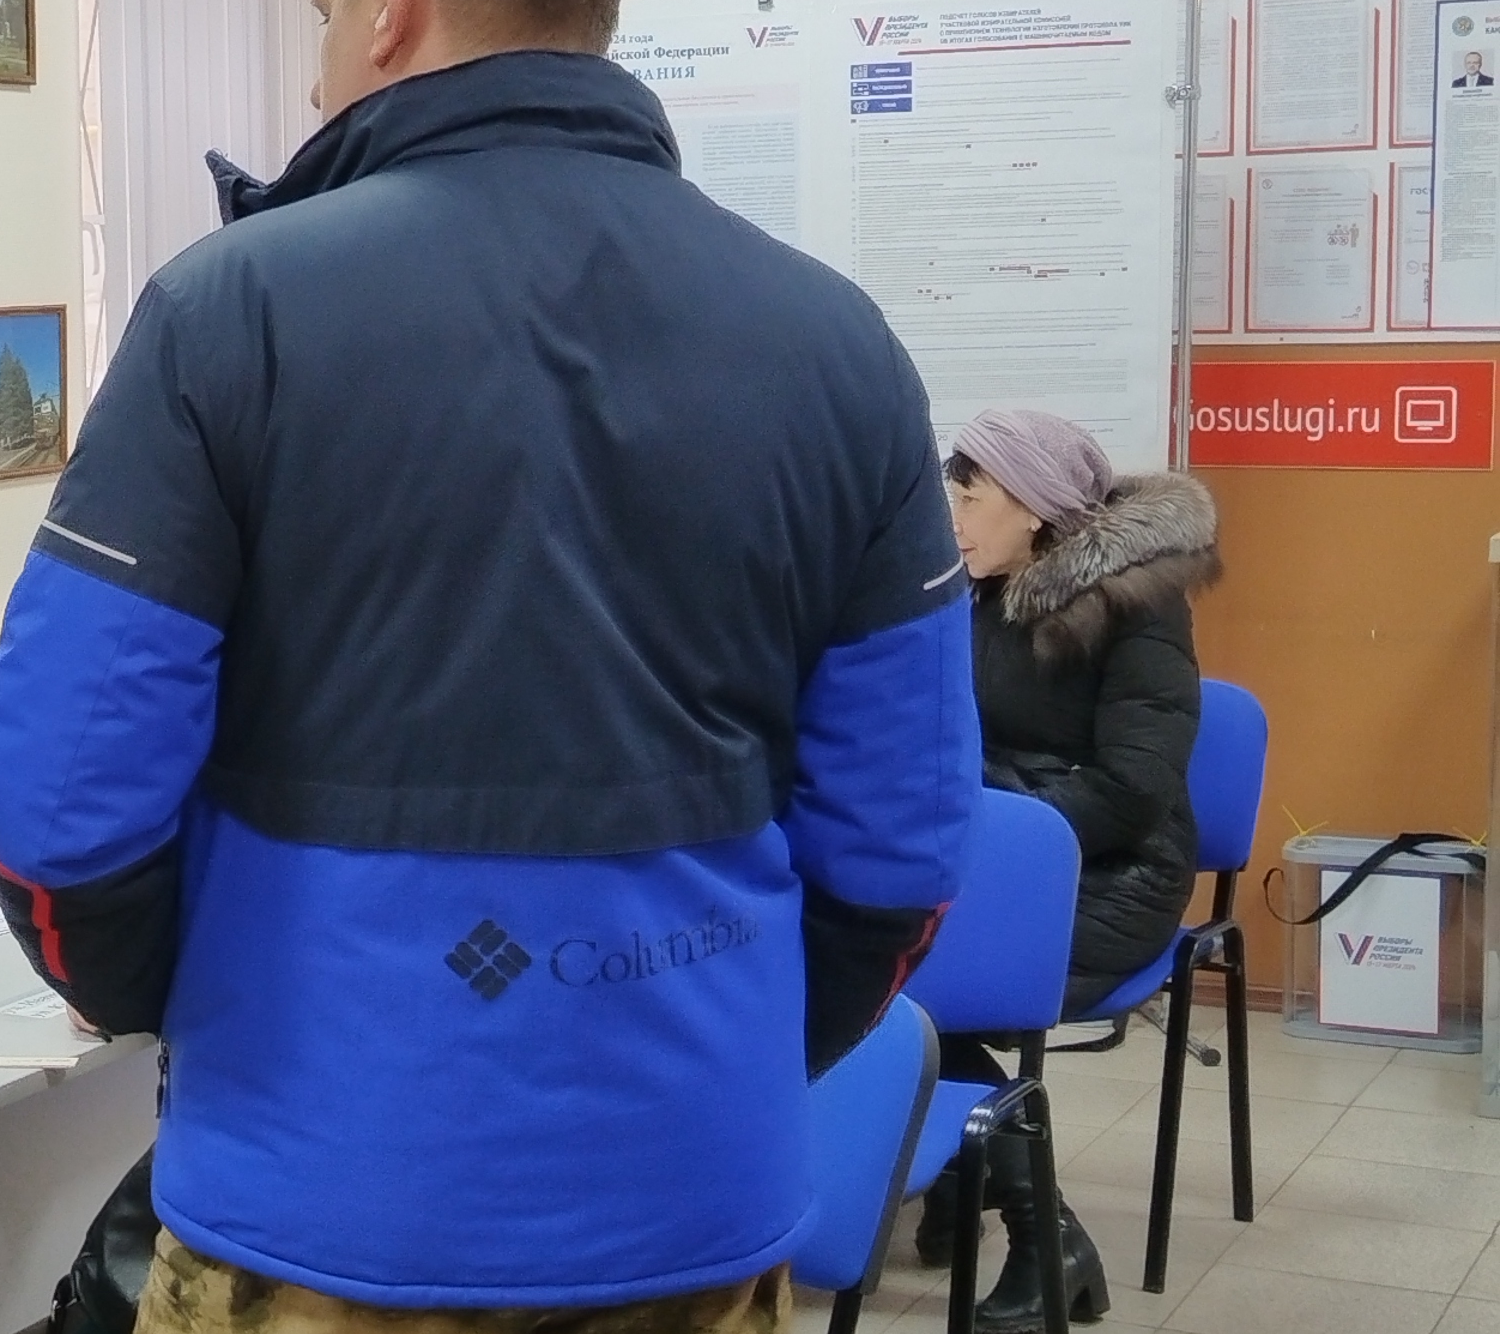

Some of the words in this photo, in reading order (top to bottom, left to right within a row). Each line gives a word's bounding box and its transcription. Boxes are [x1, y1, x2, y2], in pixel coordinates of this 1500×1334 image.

[628, 35, 654, 44] года
[607, 48, 650, 61] йской
[654, 46, 730, 60] Федерации
[633, 66, 695, 80] ВАНИЯ
[1378, 936, 1413, 945] ВЫБОРЫ
